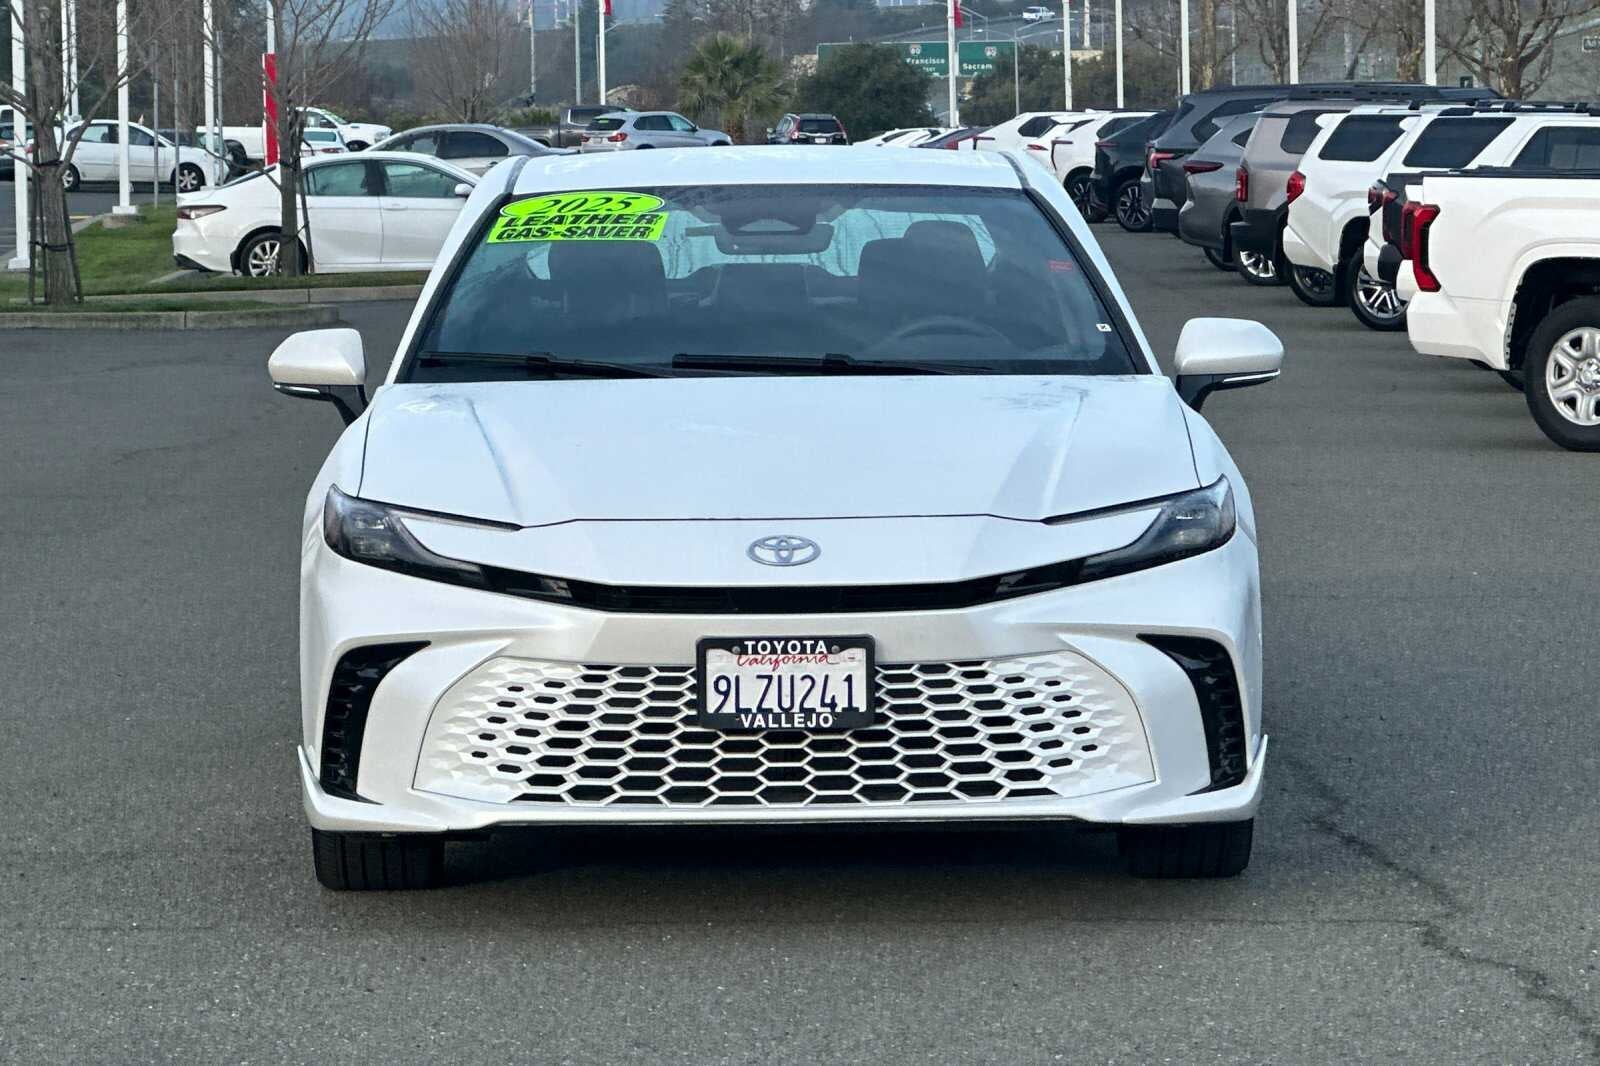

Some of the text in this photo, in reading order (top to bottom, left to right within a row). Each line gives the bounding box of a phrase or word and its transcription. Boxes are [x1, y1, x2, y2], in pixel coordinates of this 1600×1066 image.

[528, 197, 641, 214] 2025
[502, 214, 663, 227] LEATHER
[496, 226, 654, 240] GAS-SAVER
[744, 640, 828, 654] TOYOTA
[736, 654, 839, 671] California
[714, 674, 860, 713] 9LZU241
[740, 714, 833, 728] VALLEJO
